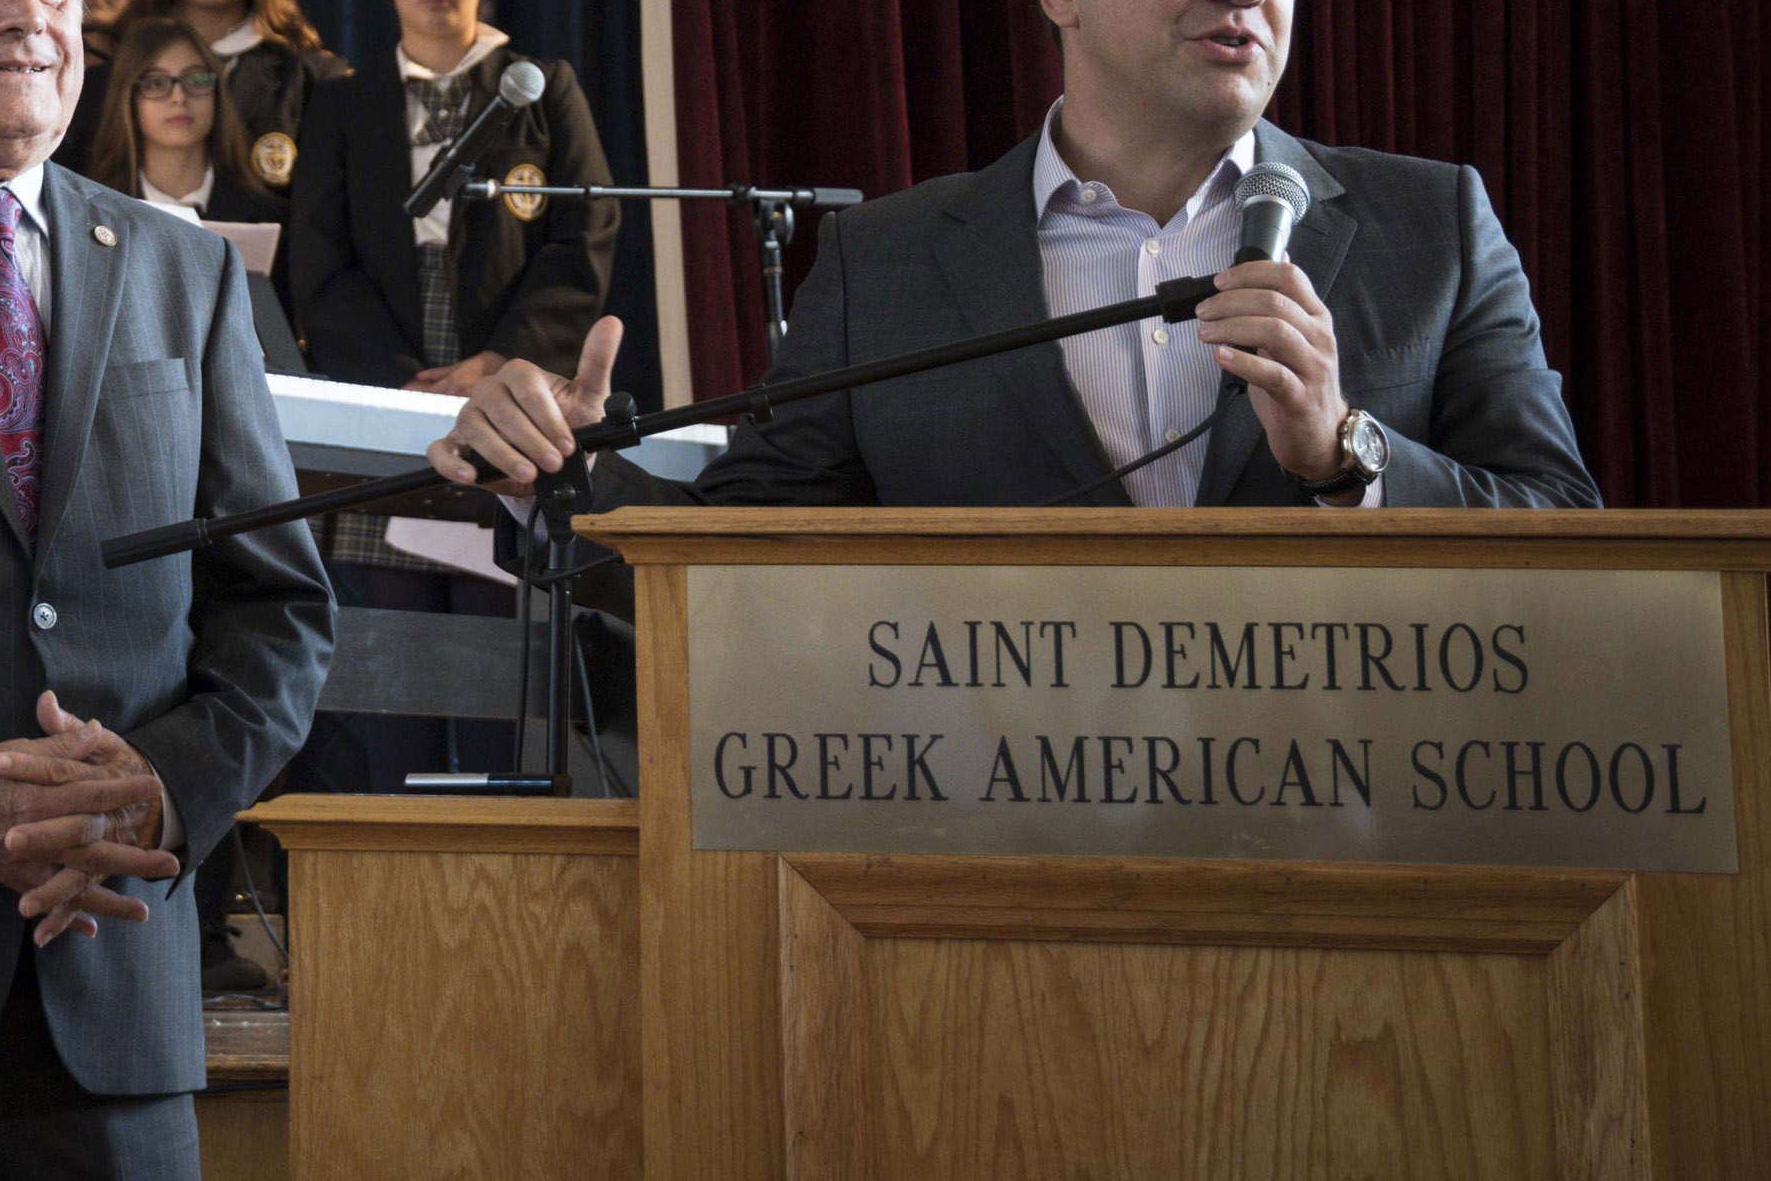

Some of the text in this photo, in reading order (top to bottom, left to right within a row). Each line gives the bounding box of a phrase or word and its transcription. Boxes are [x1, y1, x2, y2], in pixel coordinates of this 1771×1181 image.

[867, 620, 1530, 695] SAINT DEMETRIOS
[713, 731, 1708, 815] GREEK AMERICAN SCHOOL
